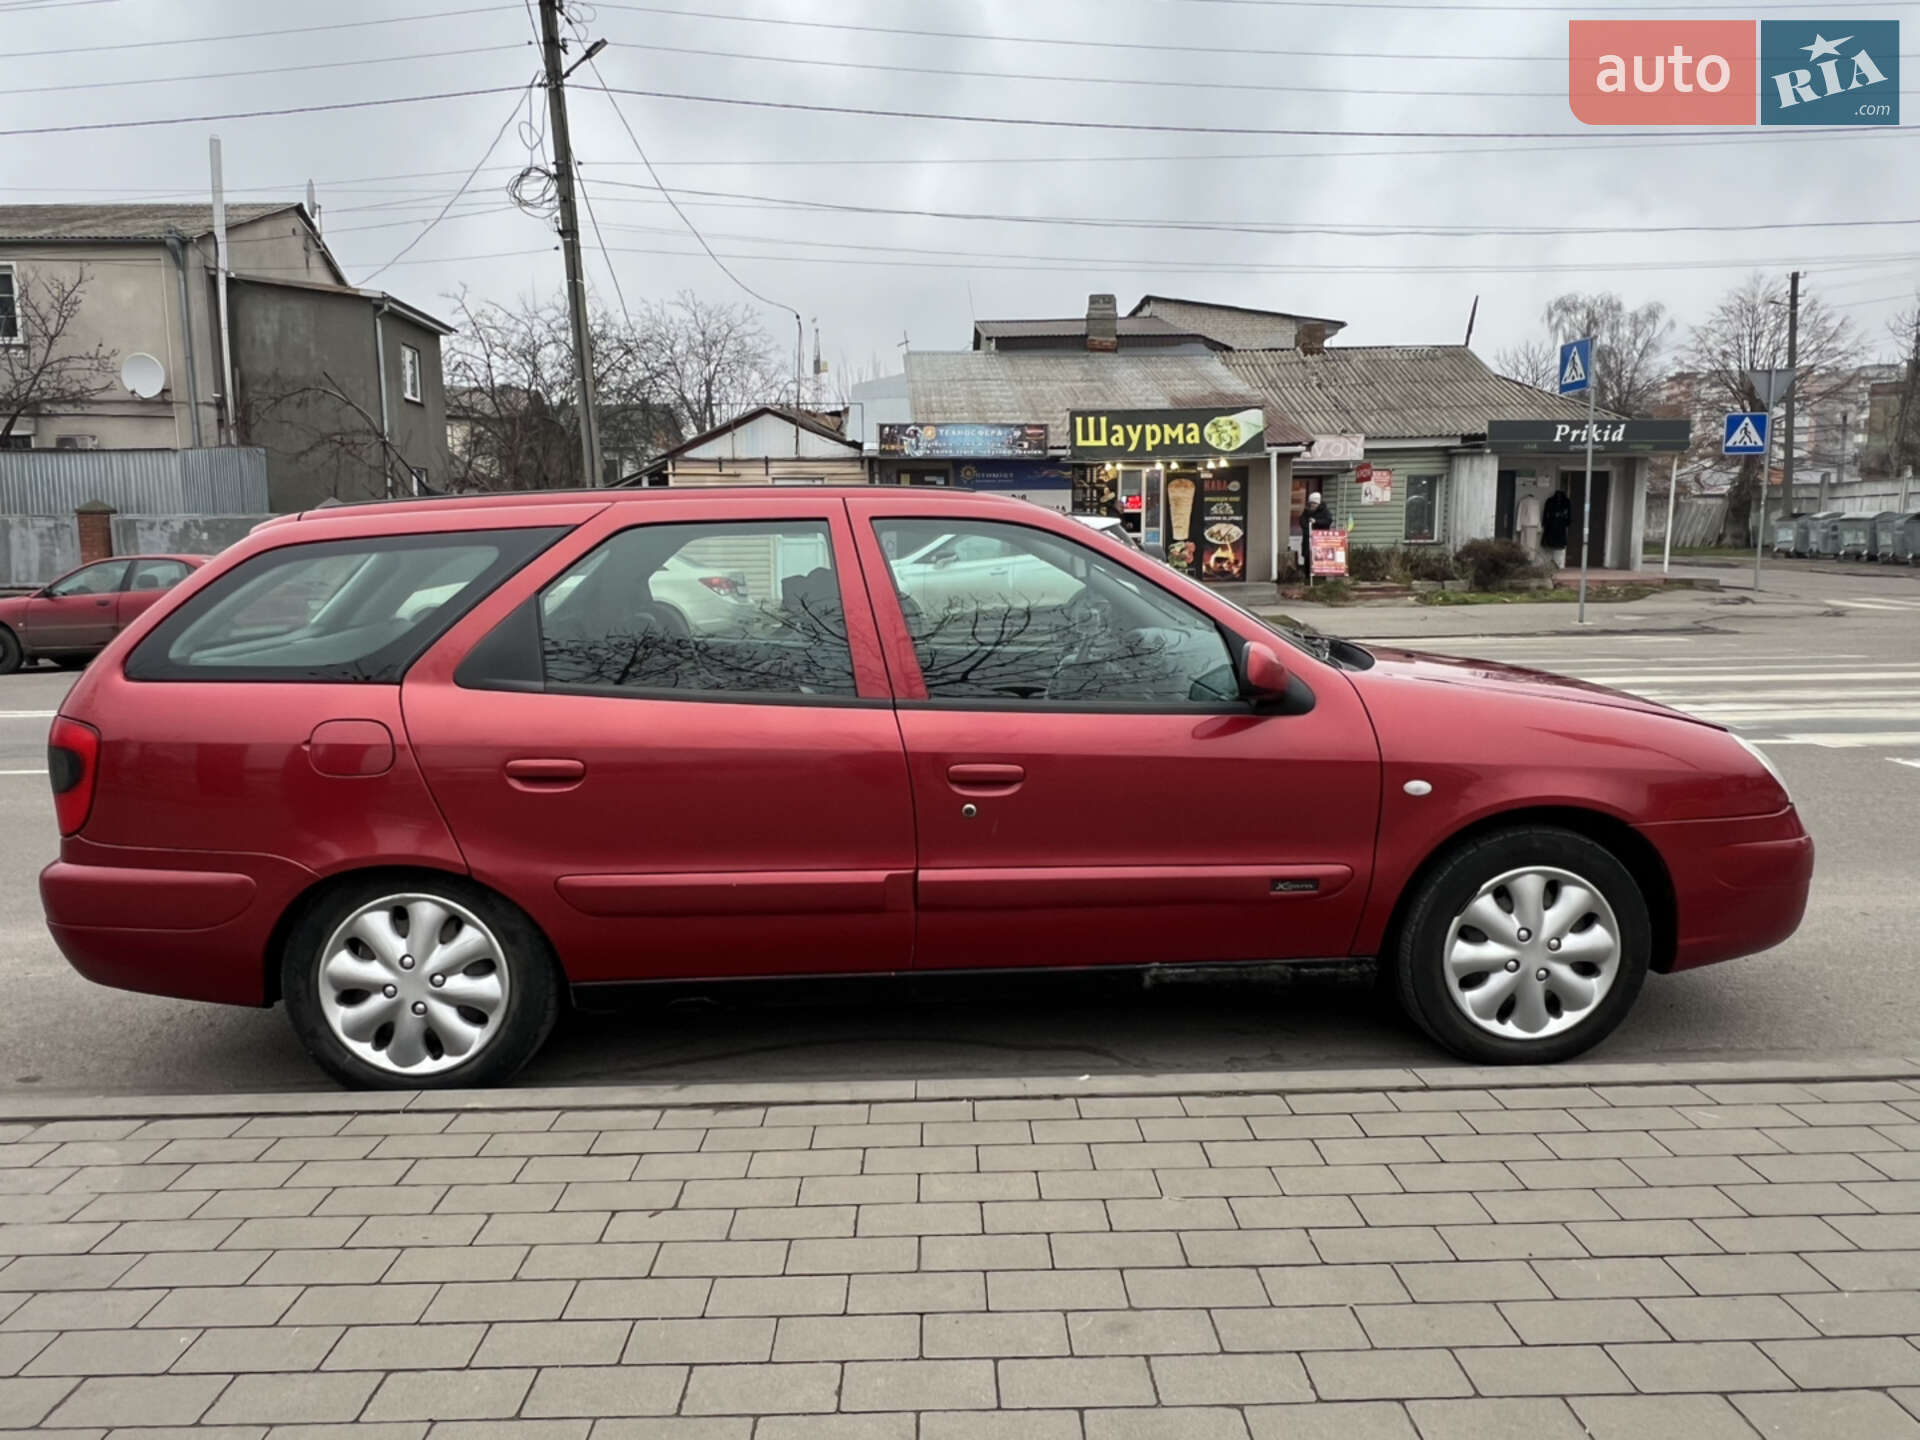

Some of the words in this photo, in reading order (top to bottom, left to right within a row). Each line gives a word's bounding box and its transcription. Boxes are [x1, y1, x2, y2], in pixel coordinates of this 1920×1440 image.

[1075, 416, 1201, 452] Шаурма
[1553, 424, 1626, 442] Prikid
[1313, 436, 1363, 457] VON
